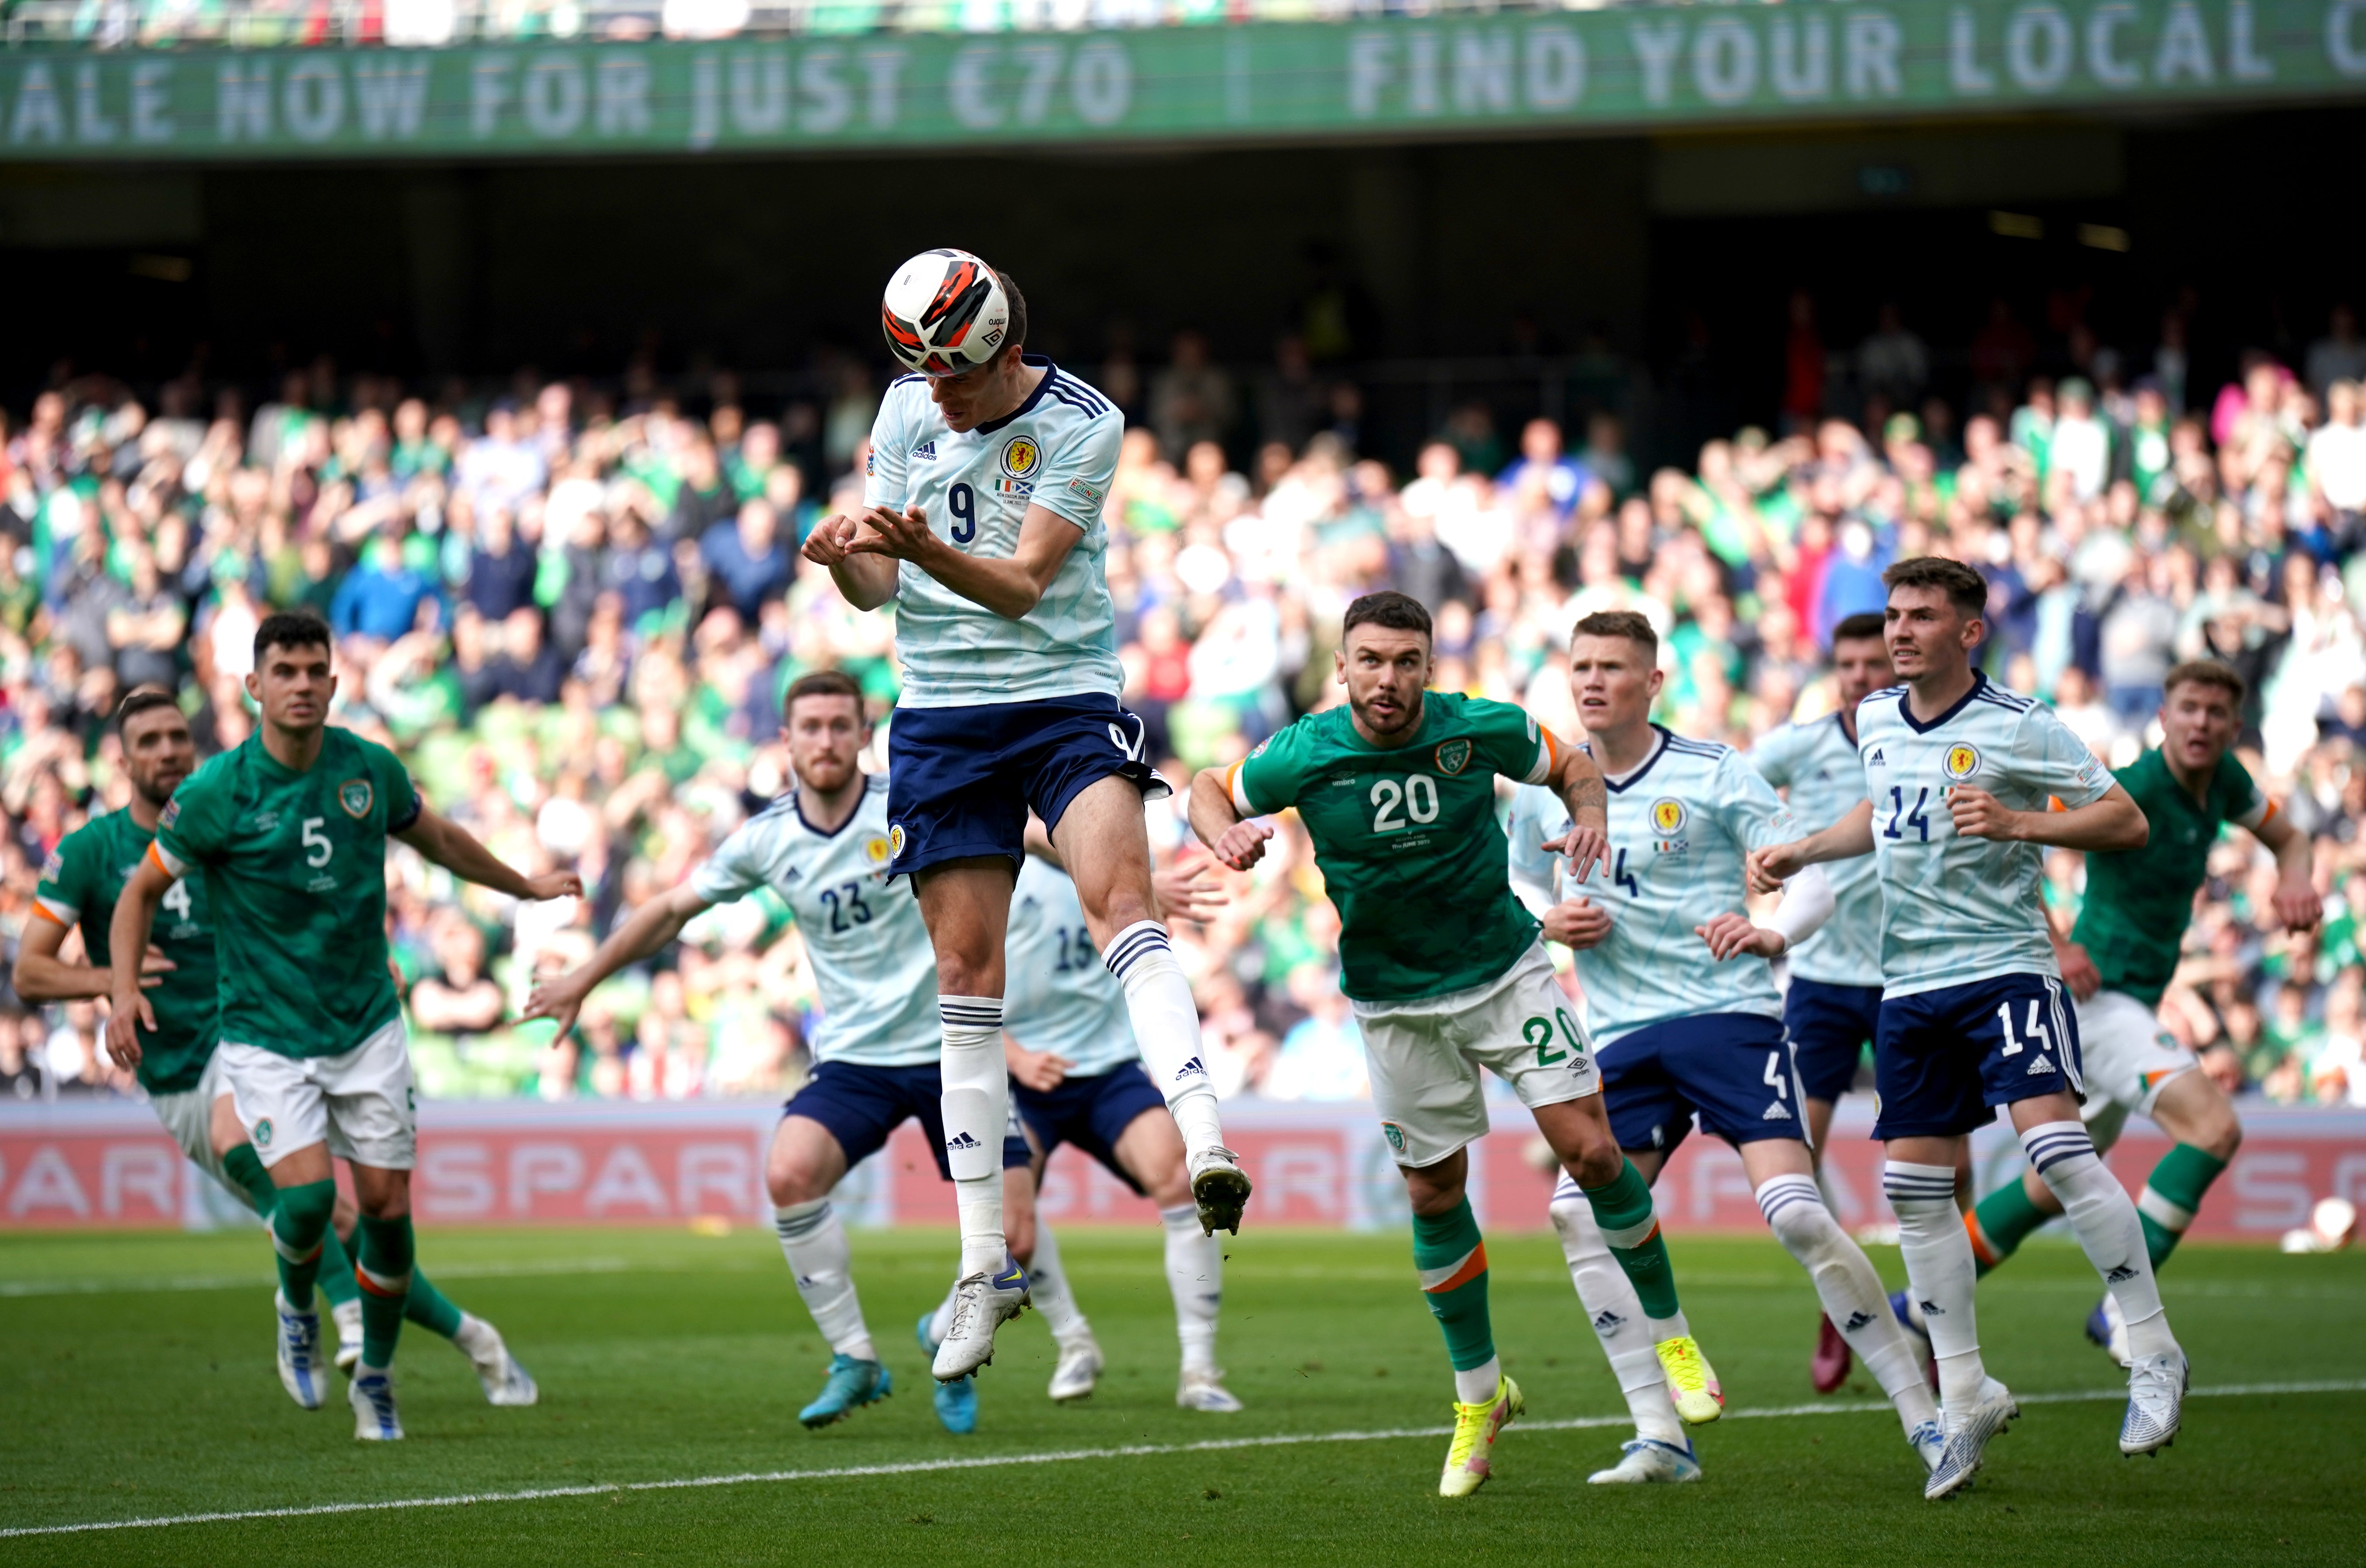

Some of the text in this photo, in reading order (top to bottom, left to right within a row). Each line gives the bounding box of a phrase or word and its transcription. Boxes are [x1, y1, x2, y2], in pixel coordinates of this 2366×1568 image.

[1349, 24, 1588, 118] FIND
[1631, 13, 1902, 110] YOUR
[1951, 0, 2273, 95] LOCAL
[216, 54, 430, 143] NOW
[470, 51, 652, 141] FOR
[689, 44, 905, 152] JUST
[949, 37, 1131, 129] €70
[912, 451, 937, 461] adidas
[949, 483, 976, 543] 9
[1443, 743, 1465, 754] Ireland
[1369, 774, 1439, 832] 20
[1883, 785, 1929, 842] 14
[301, 817, 333, 868] 5
[162, 876, 191, 921] 4
[1615, 848, 1638, 897] 4
[820, 882, 872, 934] 23
[1056, 926, 1090, 971] 15
[1522, 1007, 1584, 1067] 20
[1997, 999, 2052, 1057] 14
[1572, 1068, 1590, 1078] umbro
[1764, 1051, 1787, 1099] 4
[2027, 1065, 2057, 1075] adidas
[0, 1145, 174, 1219] AR
[422, 1141, 754, 1218] SPAR
